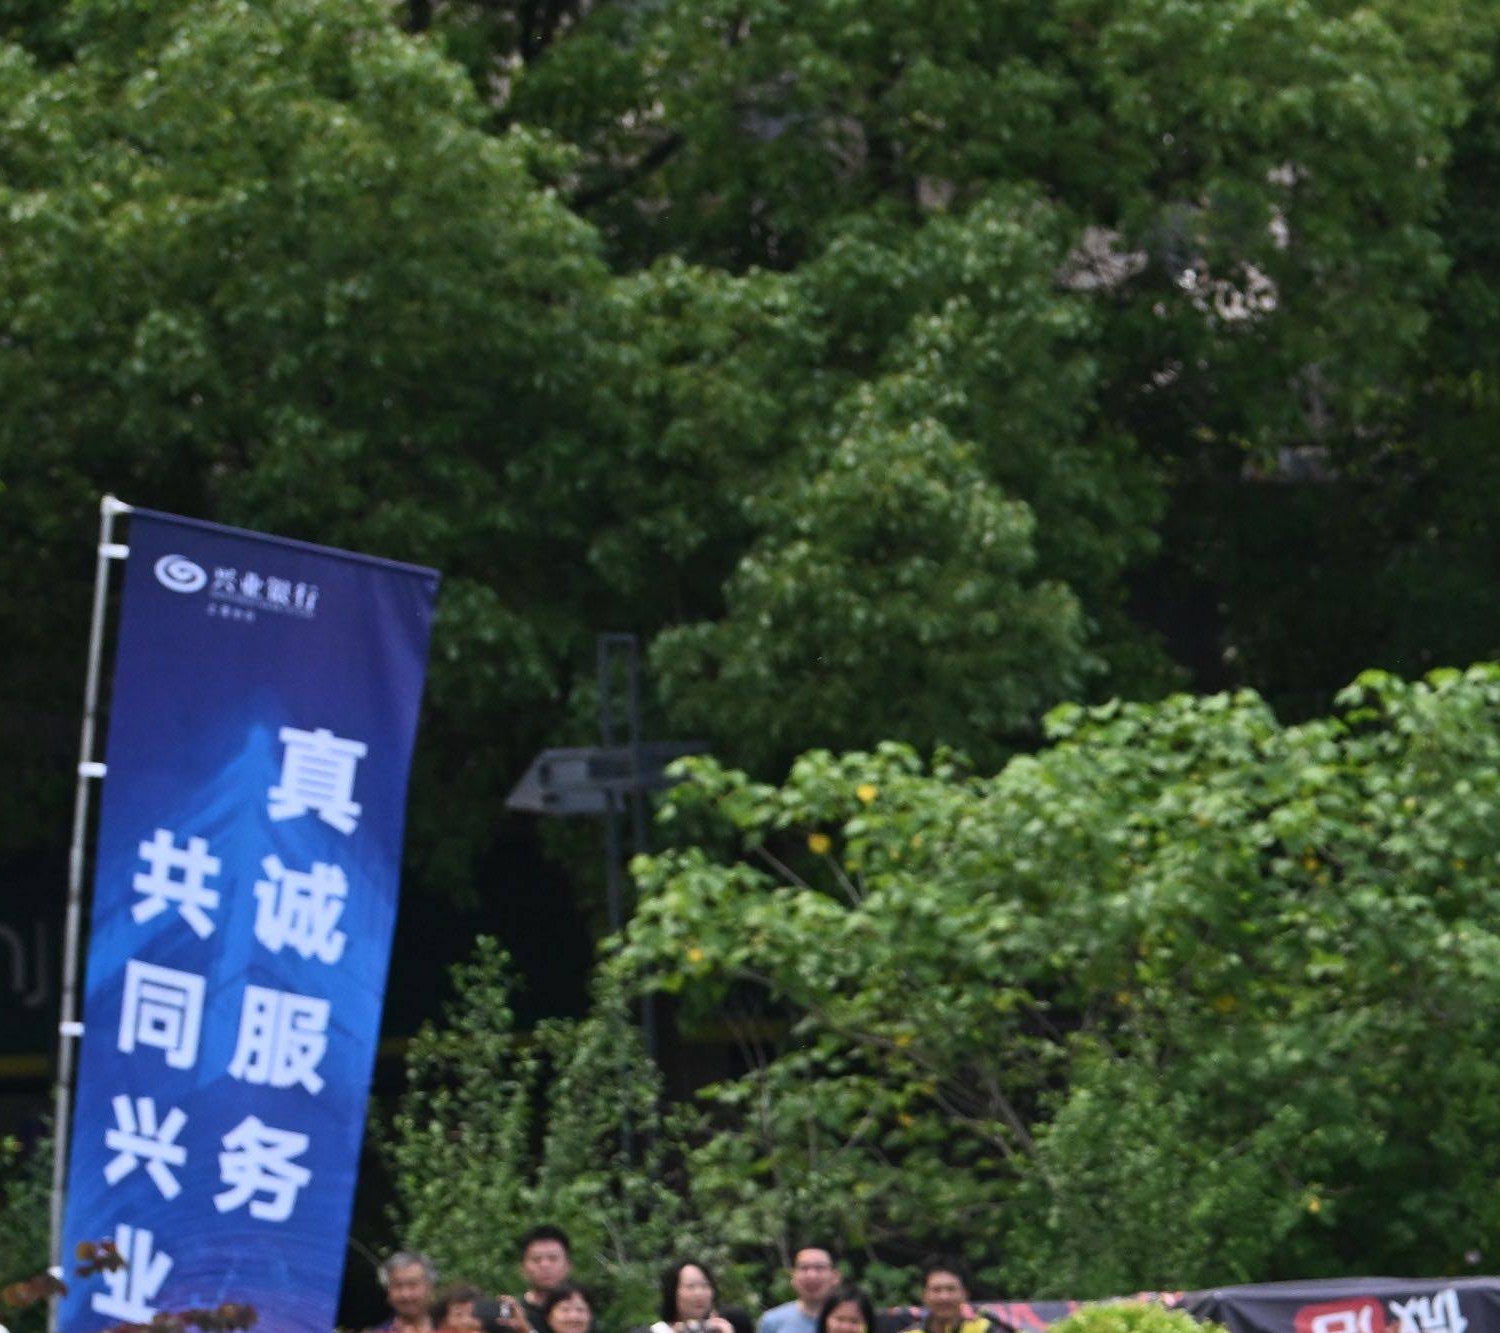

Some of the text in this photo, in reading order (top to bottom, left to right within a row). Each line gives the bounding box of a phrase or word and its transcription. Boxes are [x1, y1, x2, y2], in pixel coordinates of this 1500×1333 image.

[91, 829, 223, 1325] 共同兴业
[213, 726, 369, 1223] 真诚服务
